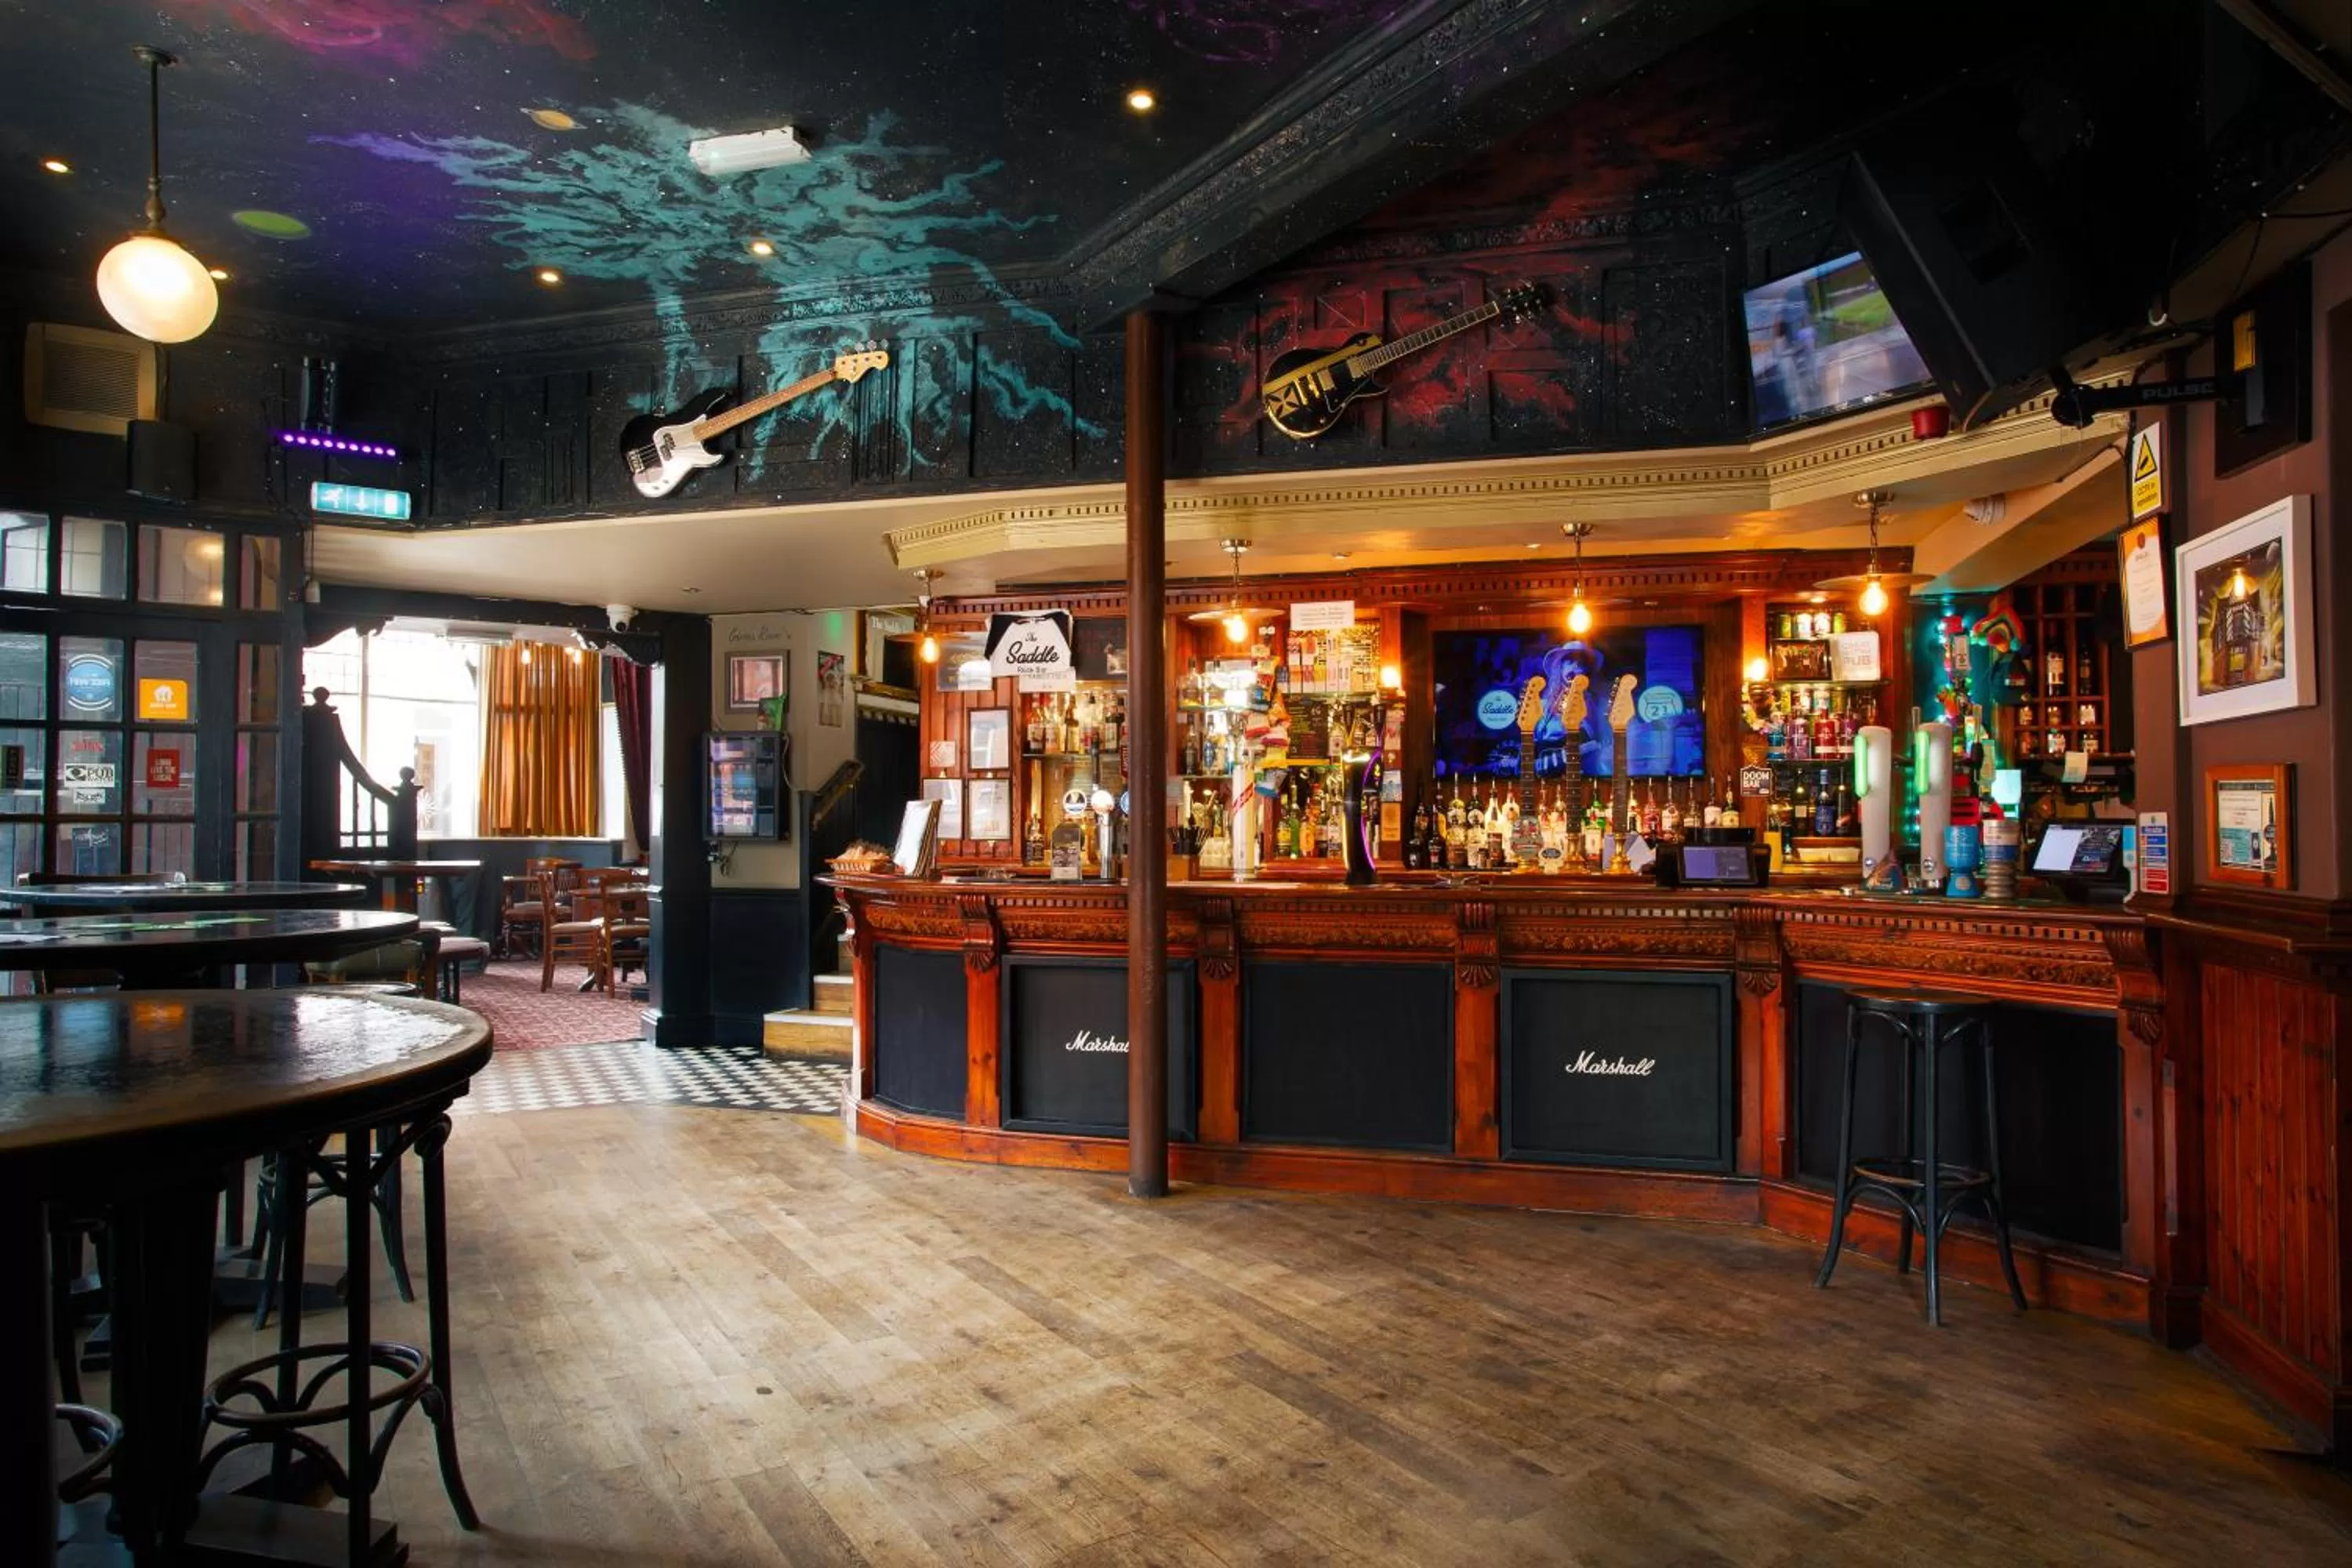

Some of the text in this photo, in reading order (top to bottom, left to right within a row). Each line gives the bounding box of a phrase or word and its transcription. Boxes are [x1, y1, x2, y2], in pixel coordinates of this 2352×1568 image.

[2142, 383, 2216, 400] PULSE
[1025, 632, 1037, 642] The
[1006, 641, 1060, 665] Saddle
[1065, 1029, 1130, 1053] Marsha
[1565, 1050, 1656, 1076] Marshall
